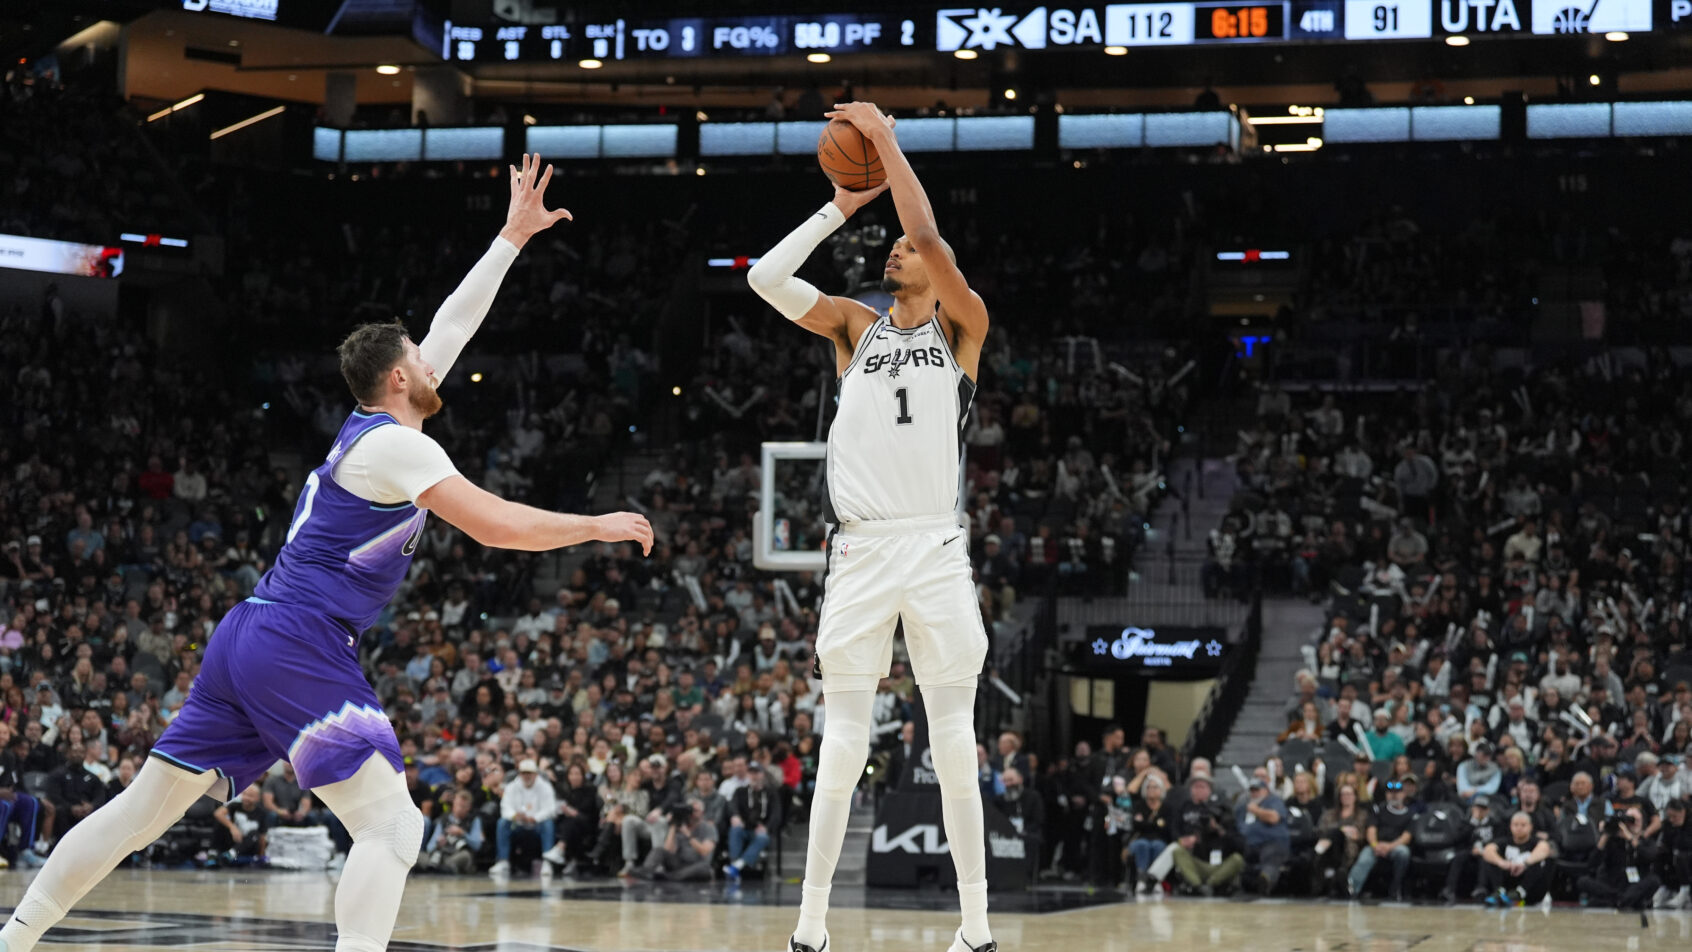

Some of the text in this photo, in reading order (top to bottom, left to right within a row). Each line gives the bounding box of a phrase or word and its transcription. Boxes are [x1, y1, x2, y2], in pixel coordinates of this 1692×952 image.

[541, 26, 571, 39] STL
[586, 25, 615, 38] BLK
[632, 29, 670, 51] TO
[713, 26, 779, 49] FG%
[845, 23, 882, 45] PF
[1049, 8, 1102, 45] SA
[1129, 12, 1172, 38] 112
[1211, 7, 1268, 38] 6:15
[1300, 10, 1334, 32] 4TH
[1374, 6, 1398, 31] 91
[1440, 0, 1521, 33] UTA
[863, 346, 945, 377] SPURS
[894, 387, 914, 426] 1
